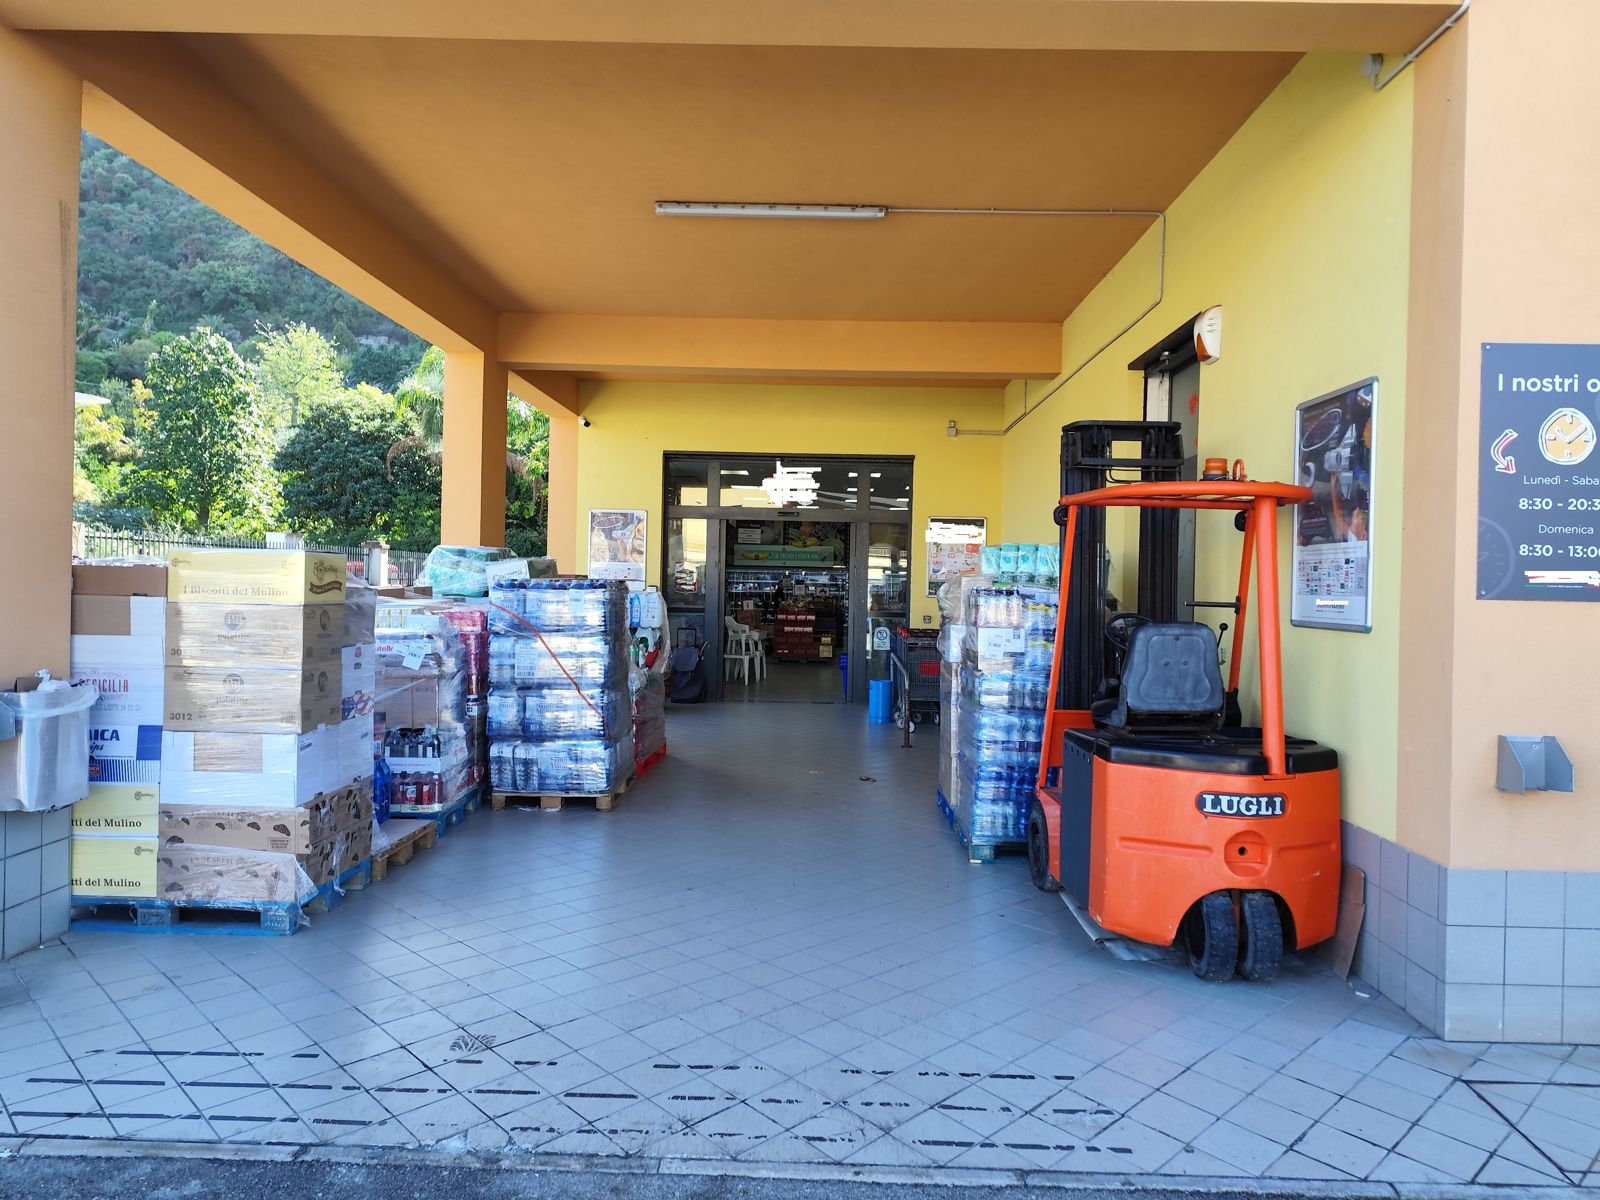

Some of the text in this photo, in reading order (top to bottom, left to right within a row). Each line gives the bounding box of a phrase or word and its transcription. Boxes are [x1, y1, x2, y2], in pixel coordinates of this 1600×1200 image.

[1498, 373, 1503, 391] I
[1512, 373, 1579, 393] nostri
[1523, 474, 1561, 485] Lunedì
[1572, 474, 1600, 486] Saba
[1518, 497, 1553, 511] 8:30
[1538, 524, 1594, 535] Domenica
[1519, 543, 1553, 557] 8:30
[1568, 545, 1600, 558] 13:0
[183, 585, 289, 596] I Biscotti del Mulino
[169, 712, 193, 721] 3012
[1202, 794, 1283, 816] LUGLI
[85, 818, 101, 827] del
[104, 818, 142, 828] Mulino
[85, 878, 101, 887] del
[103, 878, 141, 888] Mulino
